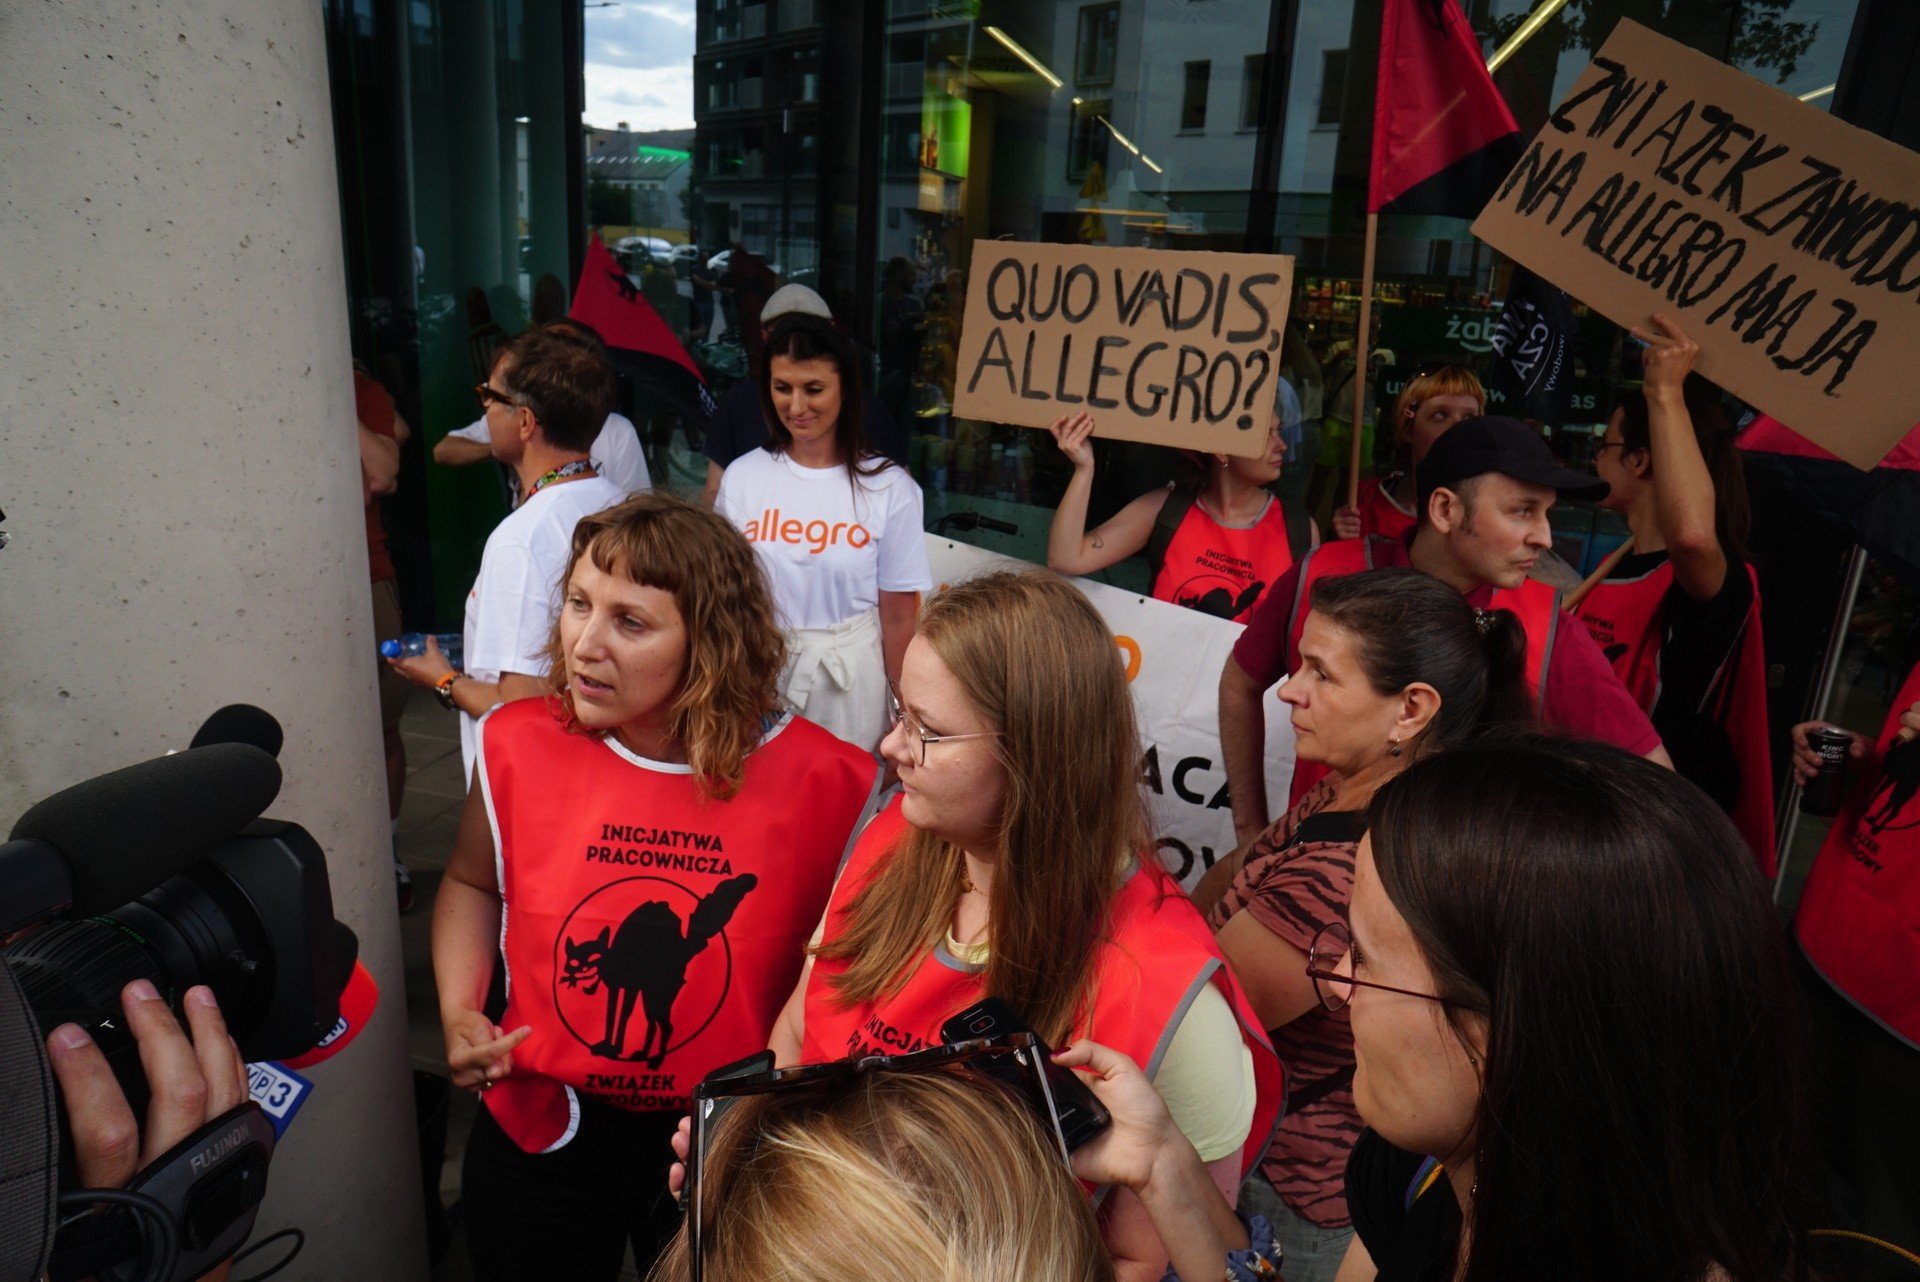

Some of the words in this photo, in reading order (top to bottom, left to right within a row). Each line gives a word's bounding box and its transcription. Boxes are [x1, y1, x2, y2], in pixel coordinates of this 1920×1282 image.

[1498, 140, 1587, 225] NA
[1561, 172, 1746, 308] ALLEGRO
[1739, 155, 1920, 305] ZAWODO
[986, 257, 1099, 324] QUO
[1114, 267, 1281, 352] VADIS,
[1445, 314, 1500, 342] żab
[967, 326, 1270, 431] ALLEGRO?
[742, 509, 871, 555] allegro
[586, 845, 733, 876] PRACOWNICZA
[601, 824, 723, 853] INICJATYWA
[864, 1013, 936, 1053] INICJA
[190, 1123, 249, 1175] FUJINON
